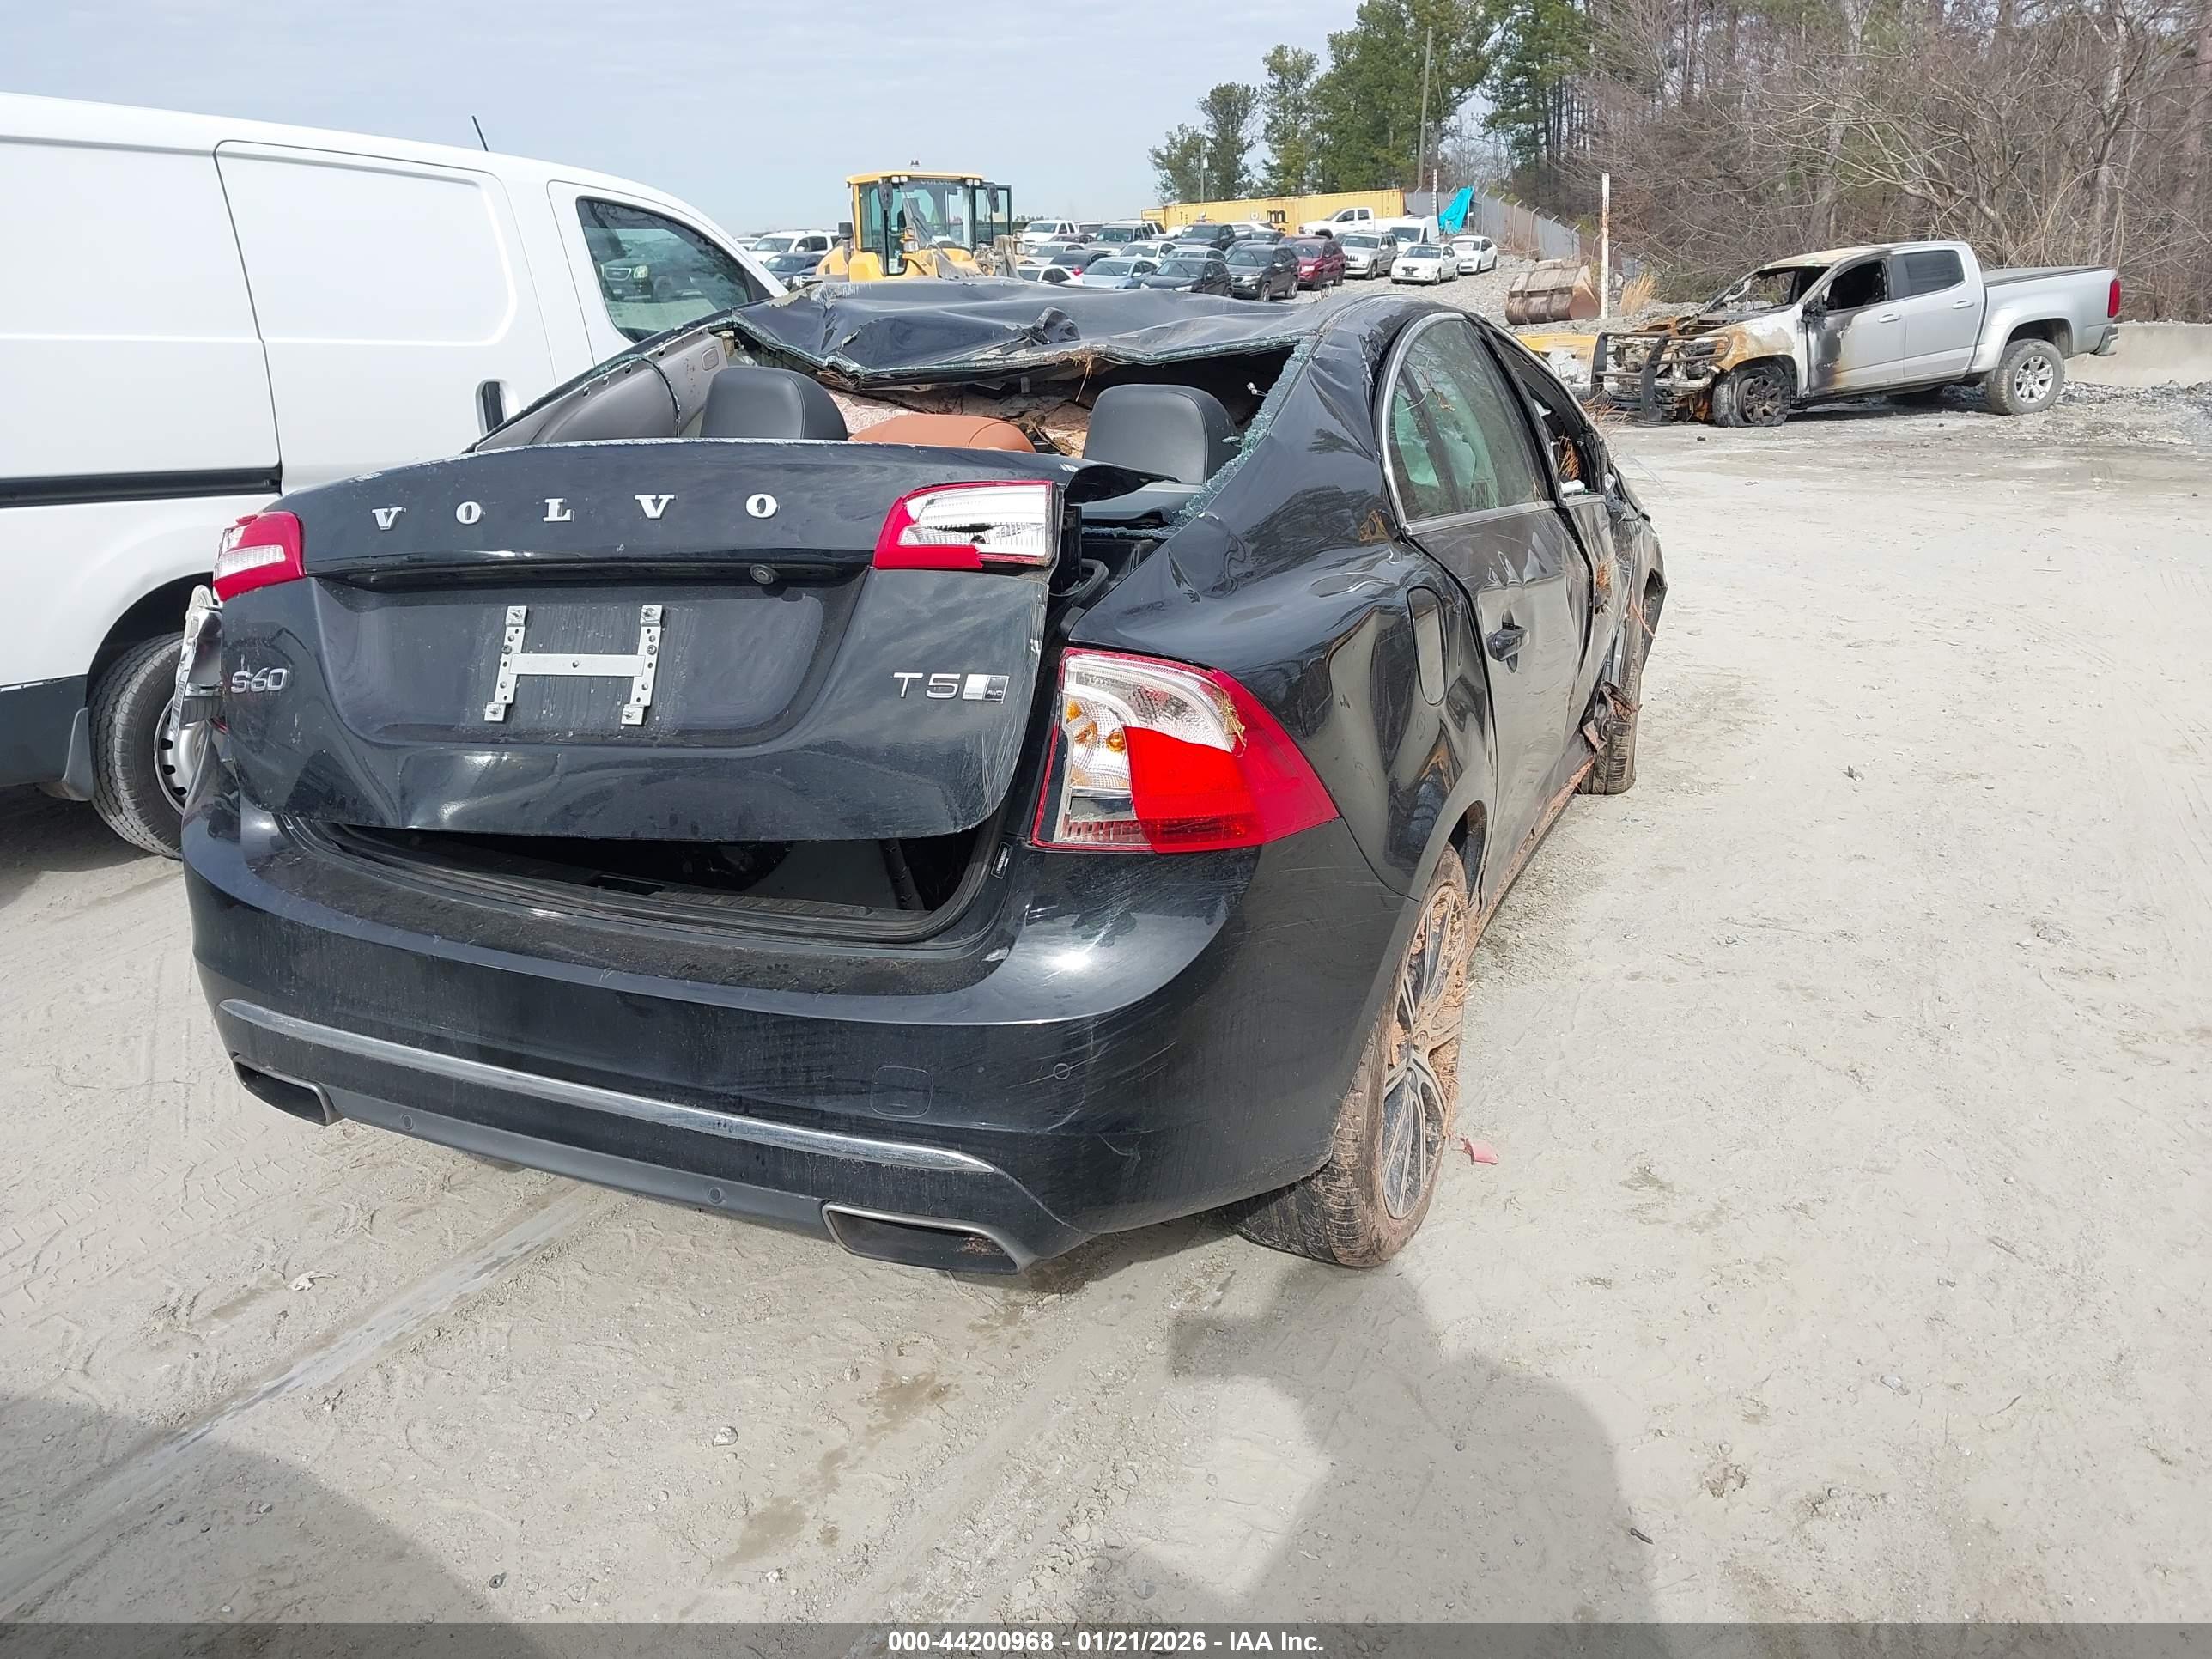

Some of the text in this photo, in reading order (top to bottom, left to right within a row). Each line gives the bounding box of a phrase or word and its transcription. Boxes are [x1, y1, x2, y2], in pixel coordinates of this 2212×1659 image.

[371, 494, 781, 531] VOLVO
[230, 667, 288, 693] S60
[893, 672, 961, 699] T5
